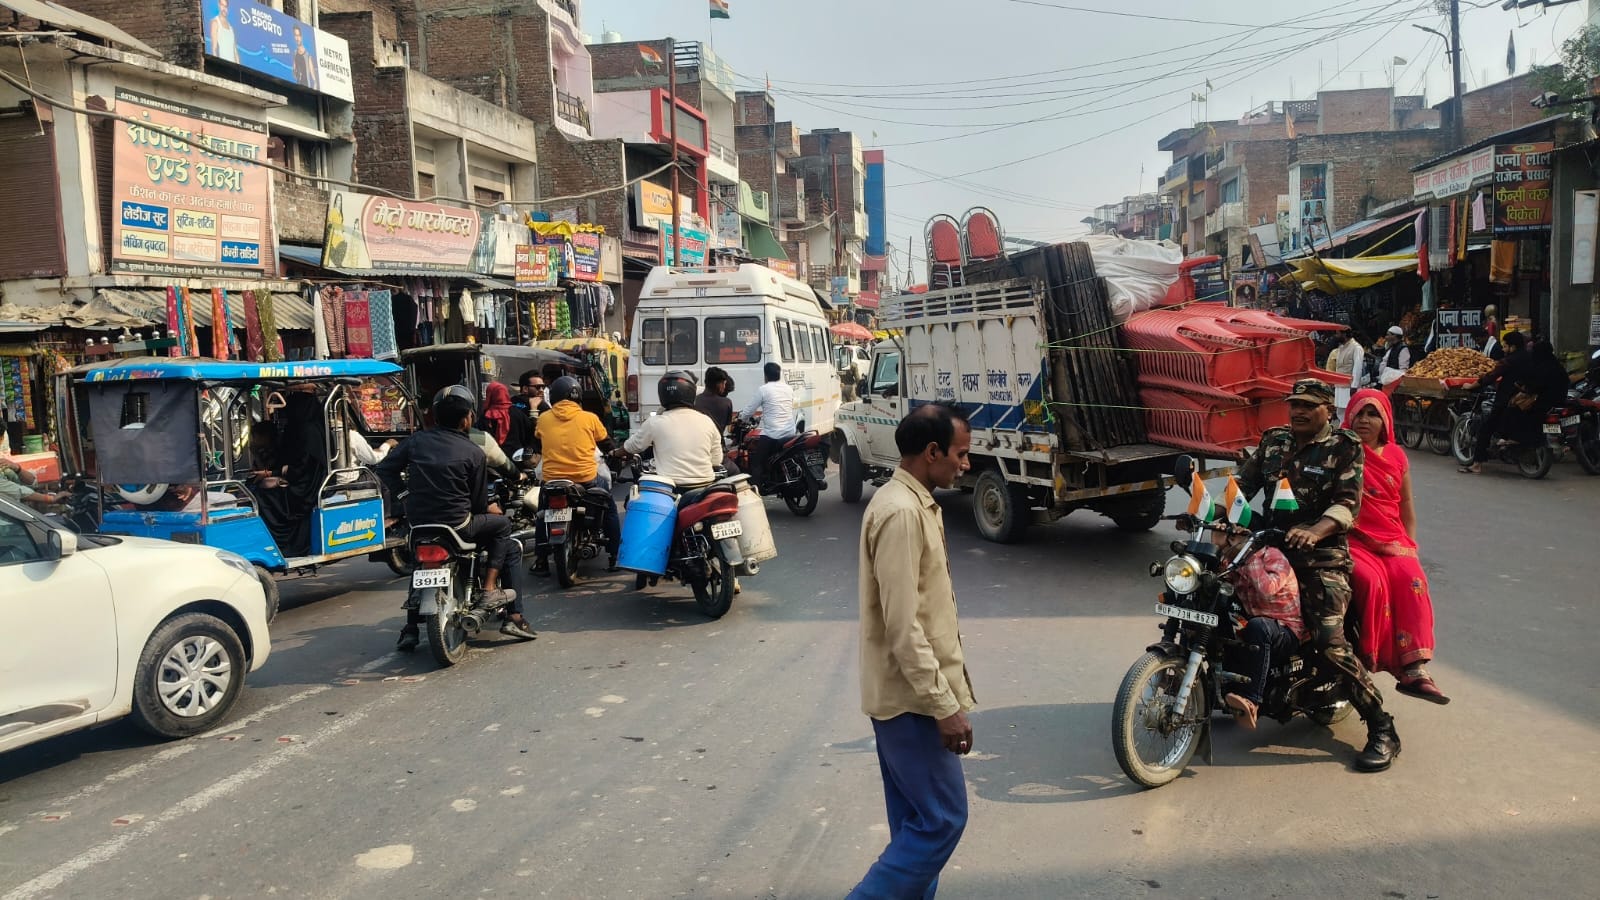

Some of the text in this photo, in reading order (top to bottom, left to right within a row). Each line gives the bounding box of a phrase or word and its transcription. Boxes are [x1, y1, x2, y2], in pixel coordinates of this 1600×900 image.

[251, 7, 272, 21] MACRO
[252, 15, 282, 37] SPORTO
[323, 47, 343, 62] METRO
[319, 58, 350, 78] GARMENTS
[1495, 152, 1551, 167] पन्ना लाल
[145, 153, 243, 192] एण्ड सन्स
[1495, 168, 1523, 182] राजेन्द्र
[159, 189, 171, 202] का
[173, 192, 186, 205] हर
[1496, 185, 1526, 203] फैन्सी
[123, 204, 167, 226] लेडीज सूट
[1506, 204, 1540, 222] विक्रेता
[1438, 309, 1481, 327] पन्ना लाल
[258, 364, 332, 378] Mini Metro
[962, 373, 980, 392] हाउस
[415, 576, 448, 587] 3914
